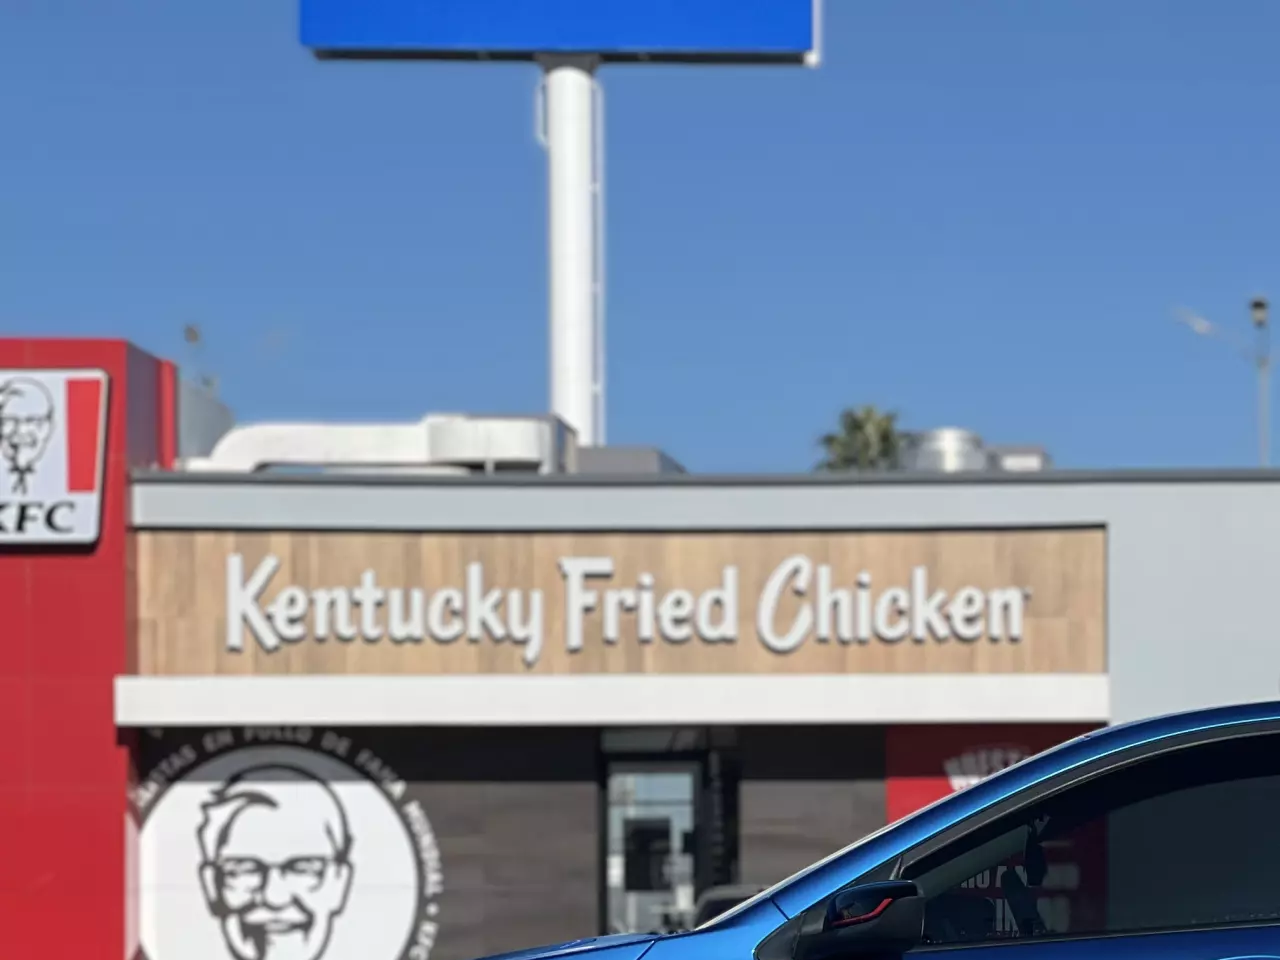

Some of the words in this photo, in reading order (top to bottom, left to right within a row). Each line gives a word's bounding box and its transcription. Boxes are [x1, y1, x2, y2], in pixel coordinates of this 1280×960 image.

[226, 552, 544, 664] Kentucky
[558, 556, 738, 652] Fried
[757, 554, 1026, 653] Chicken
